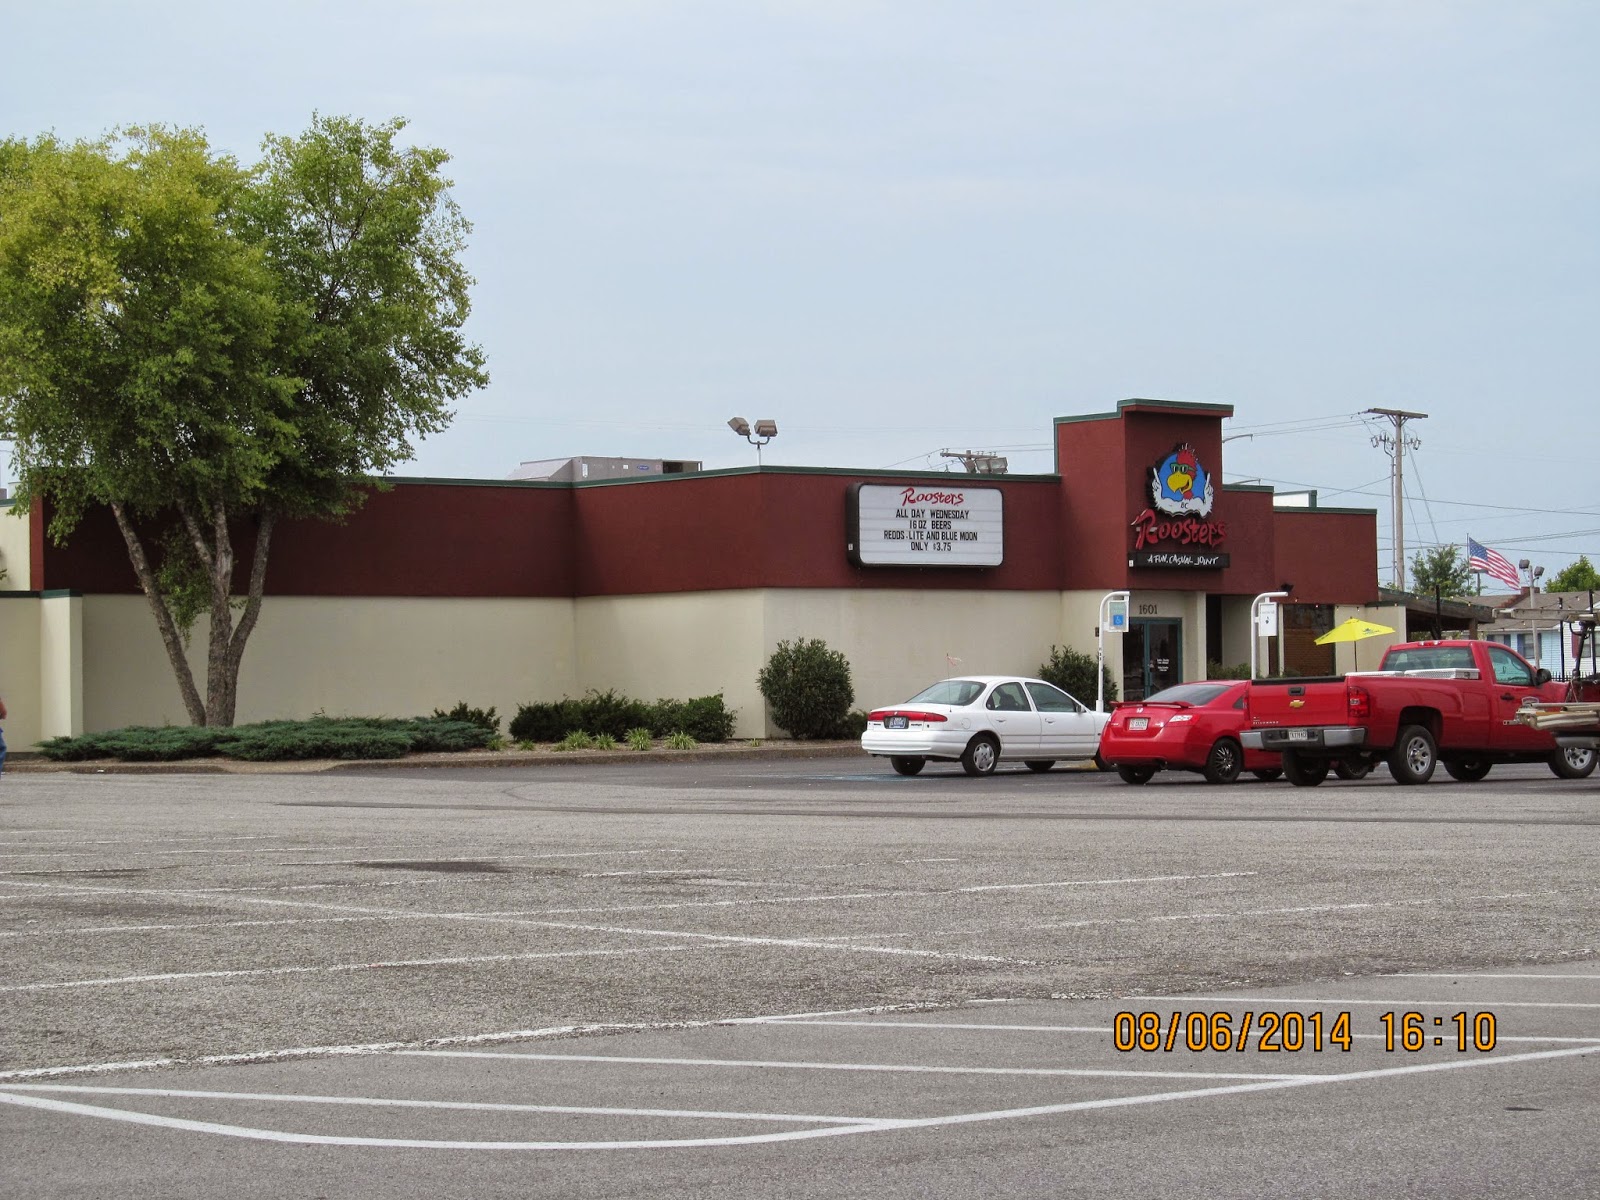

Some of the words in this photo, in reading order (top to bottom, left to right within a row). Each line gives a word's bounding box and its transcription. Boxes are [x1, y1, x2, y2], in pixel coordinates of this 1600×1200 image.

[900, 487, 964, 507] Roosters
[896, 509, 908, 518] ALL
[911, 509, 925, 518] DAY
[930, 509, 969, 519] WEDNESDAY
[909, 520, 917, 529] 16
[918, 520, 927, 529] OZ
[931, 521, 952, 530] BEERS
[1130, 508, 1228, 550] Roosters
[926, 531, 939, 540] AND
[941, 532, 957, 541] BLUE
[960, 532, 978, 541] MOON
[911, 542, 928, 551] ONLY
[933, 542, 951, 552] $3.75
[1147, 554, 1153, 563] A
[1194, 555, 1219, 565] JOINT
[1139, 604, 1158, 615] 1601
